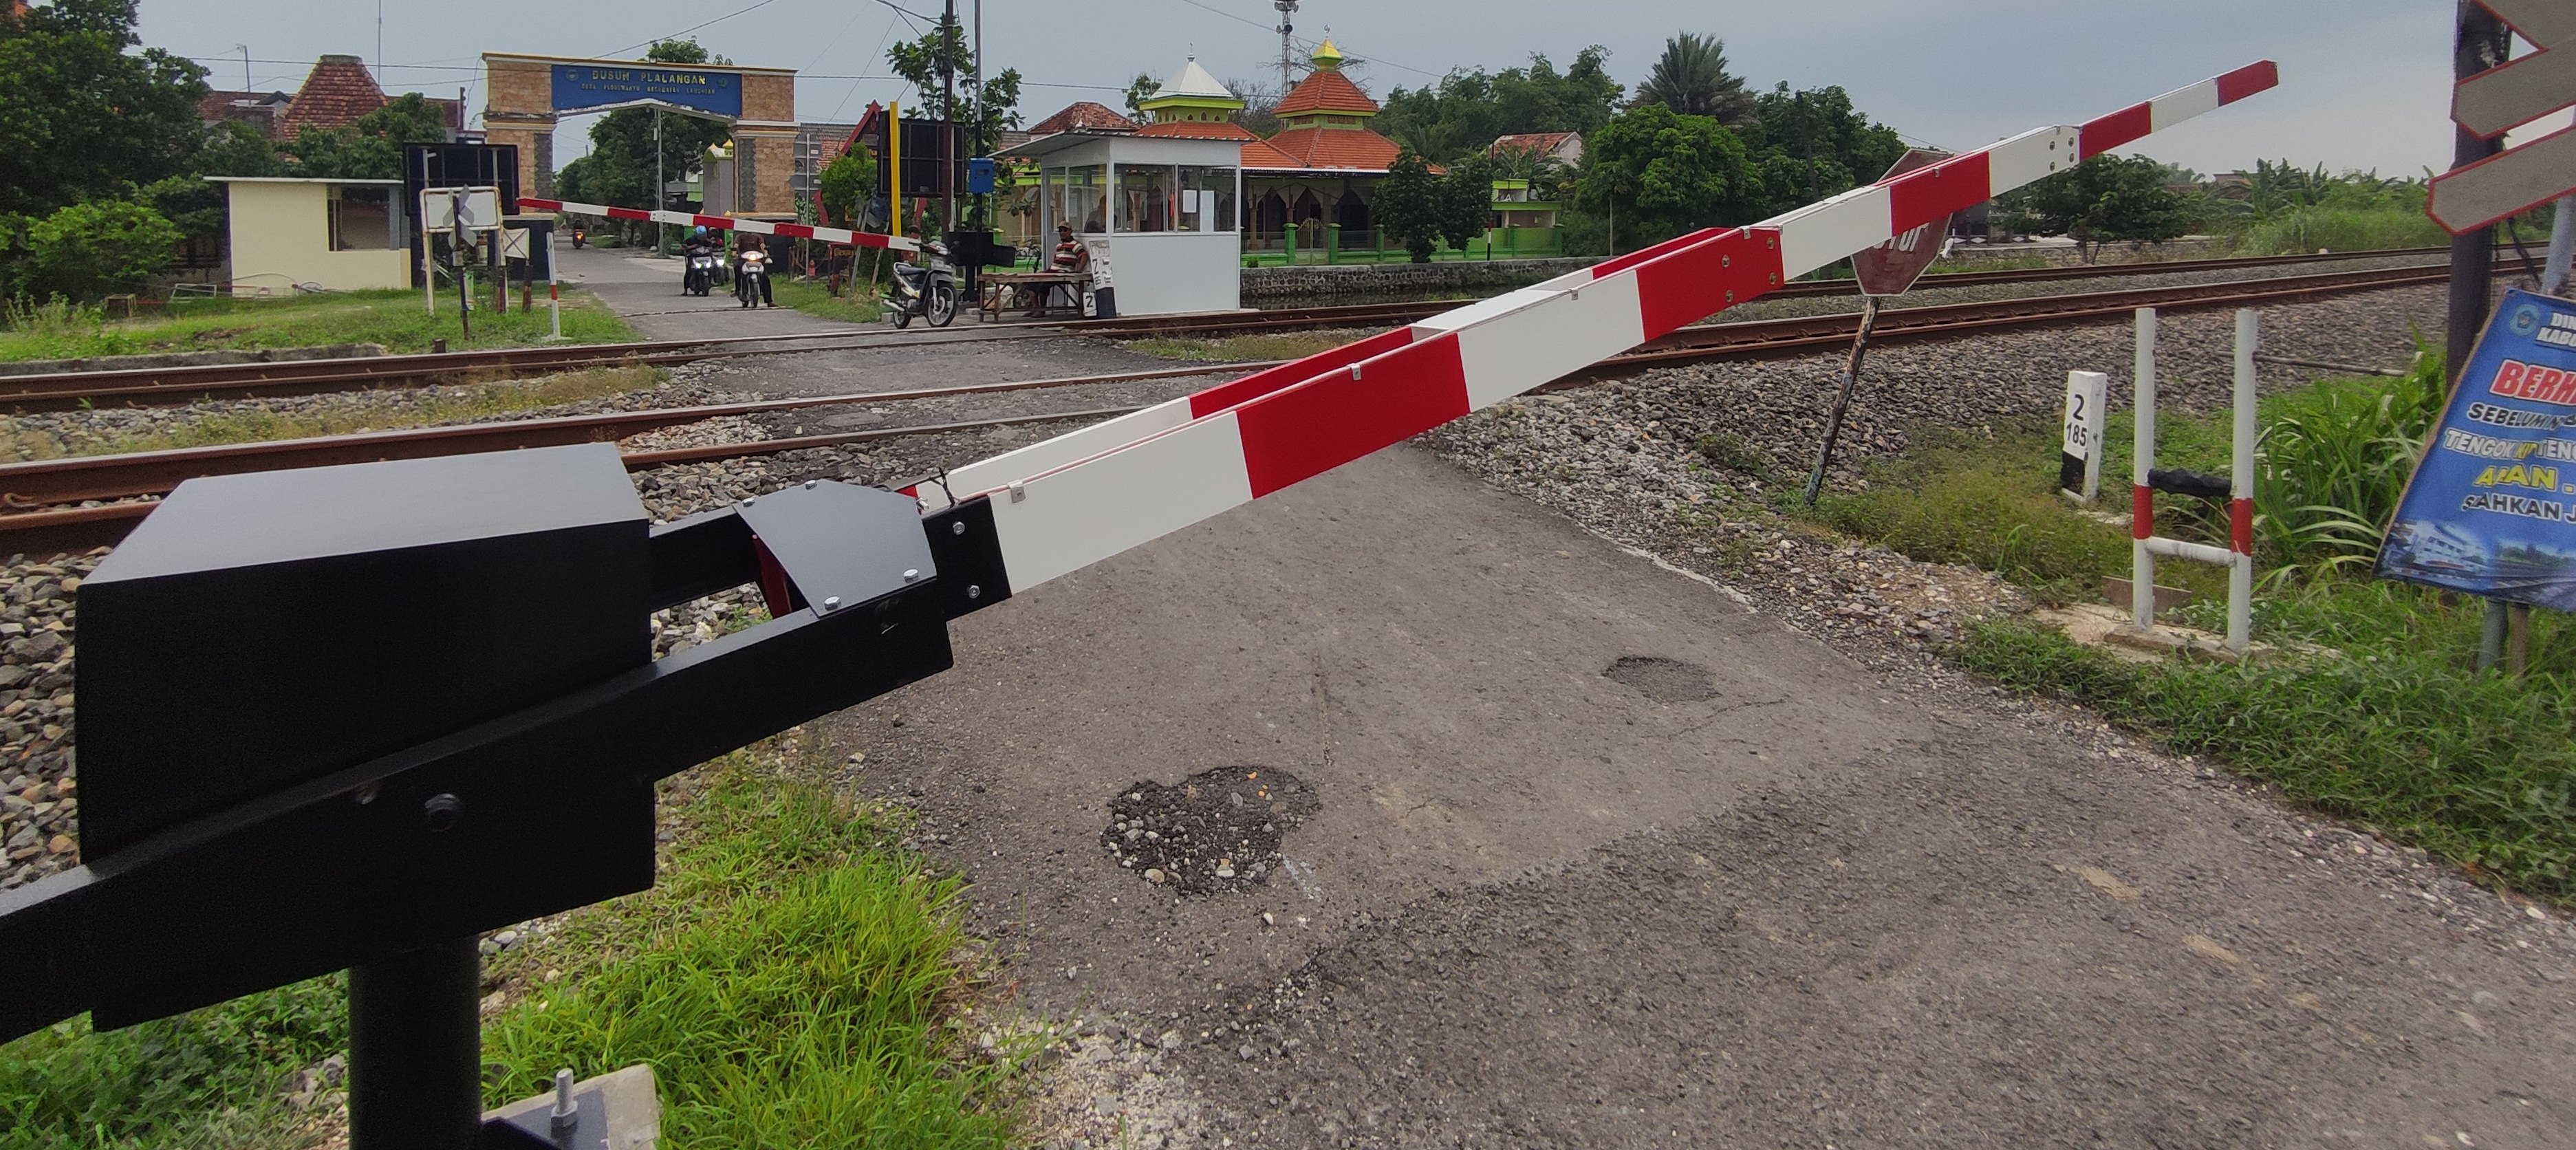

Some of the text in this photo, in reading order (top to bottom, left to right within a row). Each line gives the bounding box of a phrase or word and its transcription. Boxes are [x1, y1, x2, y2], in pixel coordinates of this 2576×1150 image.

[592, 70, 706, 85] DUSUN PLALANGAN
[2072, 393, 2085, 421] 2
[2066, 422, 2088, 447] 185
